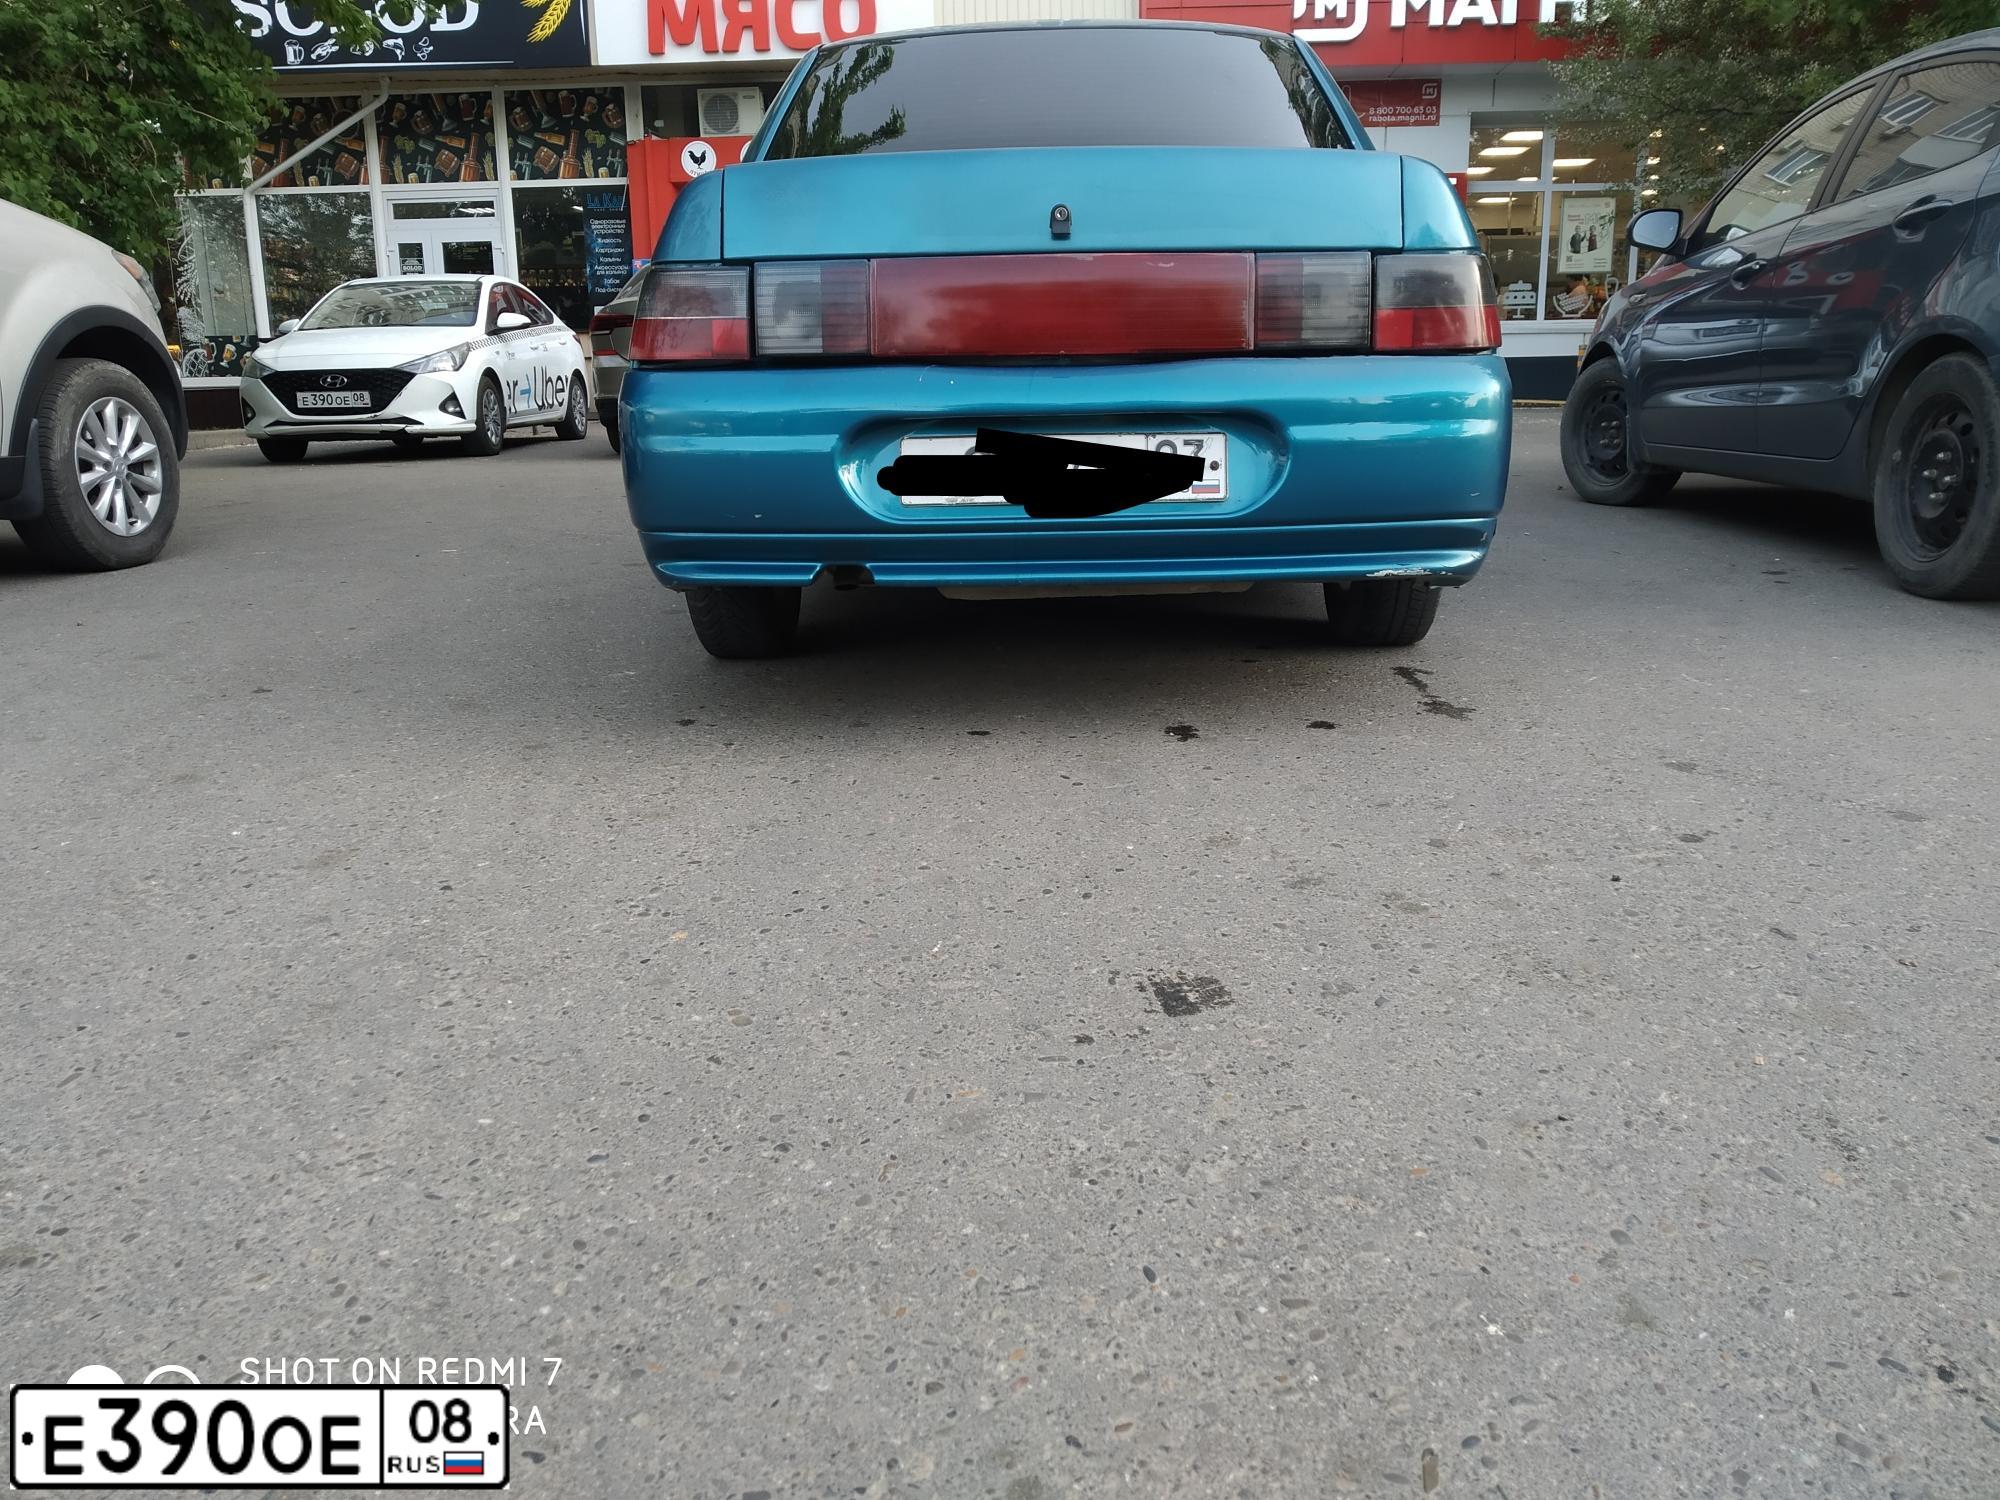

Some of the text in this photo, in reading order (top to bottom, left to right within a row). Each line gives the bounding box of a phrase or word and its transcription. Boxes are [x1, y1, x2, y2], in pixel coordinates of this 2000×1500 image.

[648, 0, 877, 55] МЯСО
[1395, 106, 1412, 114] 700
[1368, 114, 1437, 122] rabota.magnit.ru
[353, 392, 366, 402] 08
